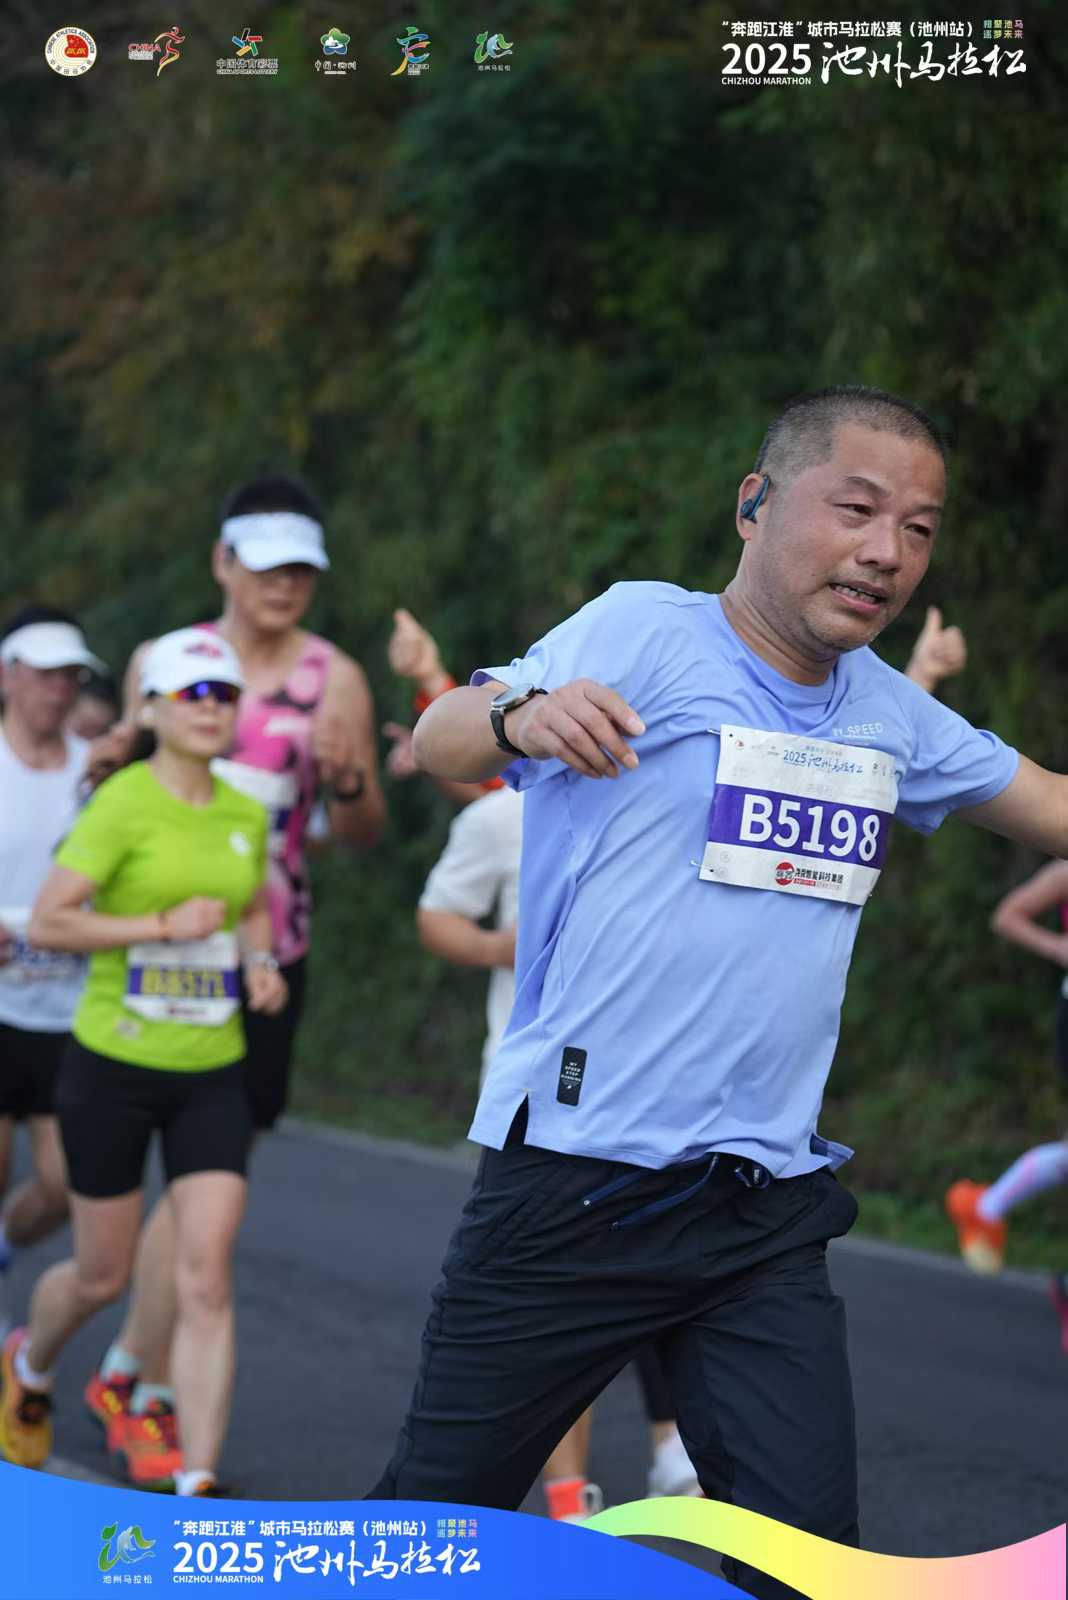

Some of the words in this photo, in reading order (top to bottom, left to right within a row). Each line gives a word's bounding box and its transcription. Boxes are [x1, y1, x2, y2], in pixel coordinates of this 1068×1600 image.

[847, 722, 884, 736] SPEED
[783, 750, 807, 764] 2025
[739, 793, 881, 862] B5198
